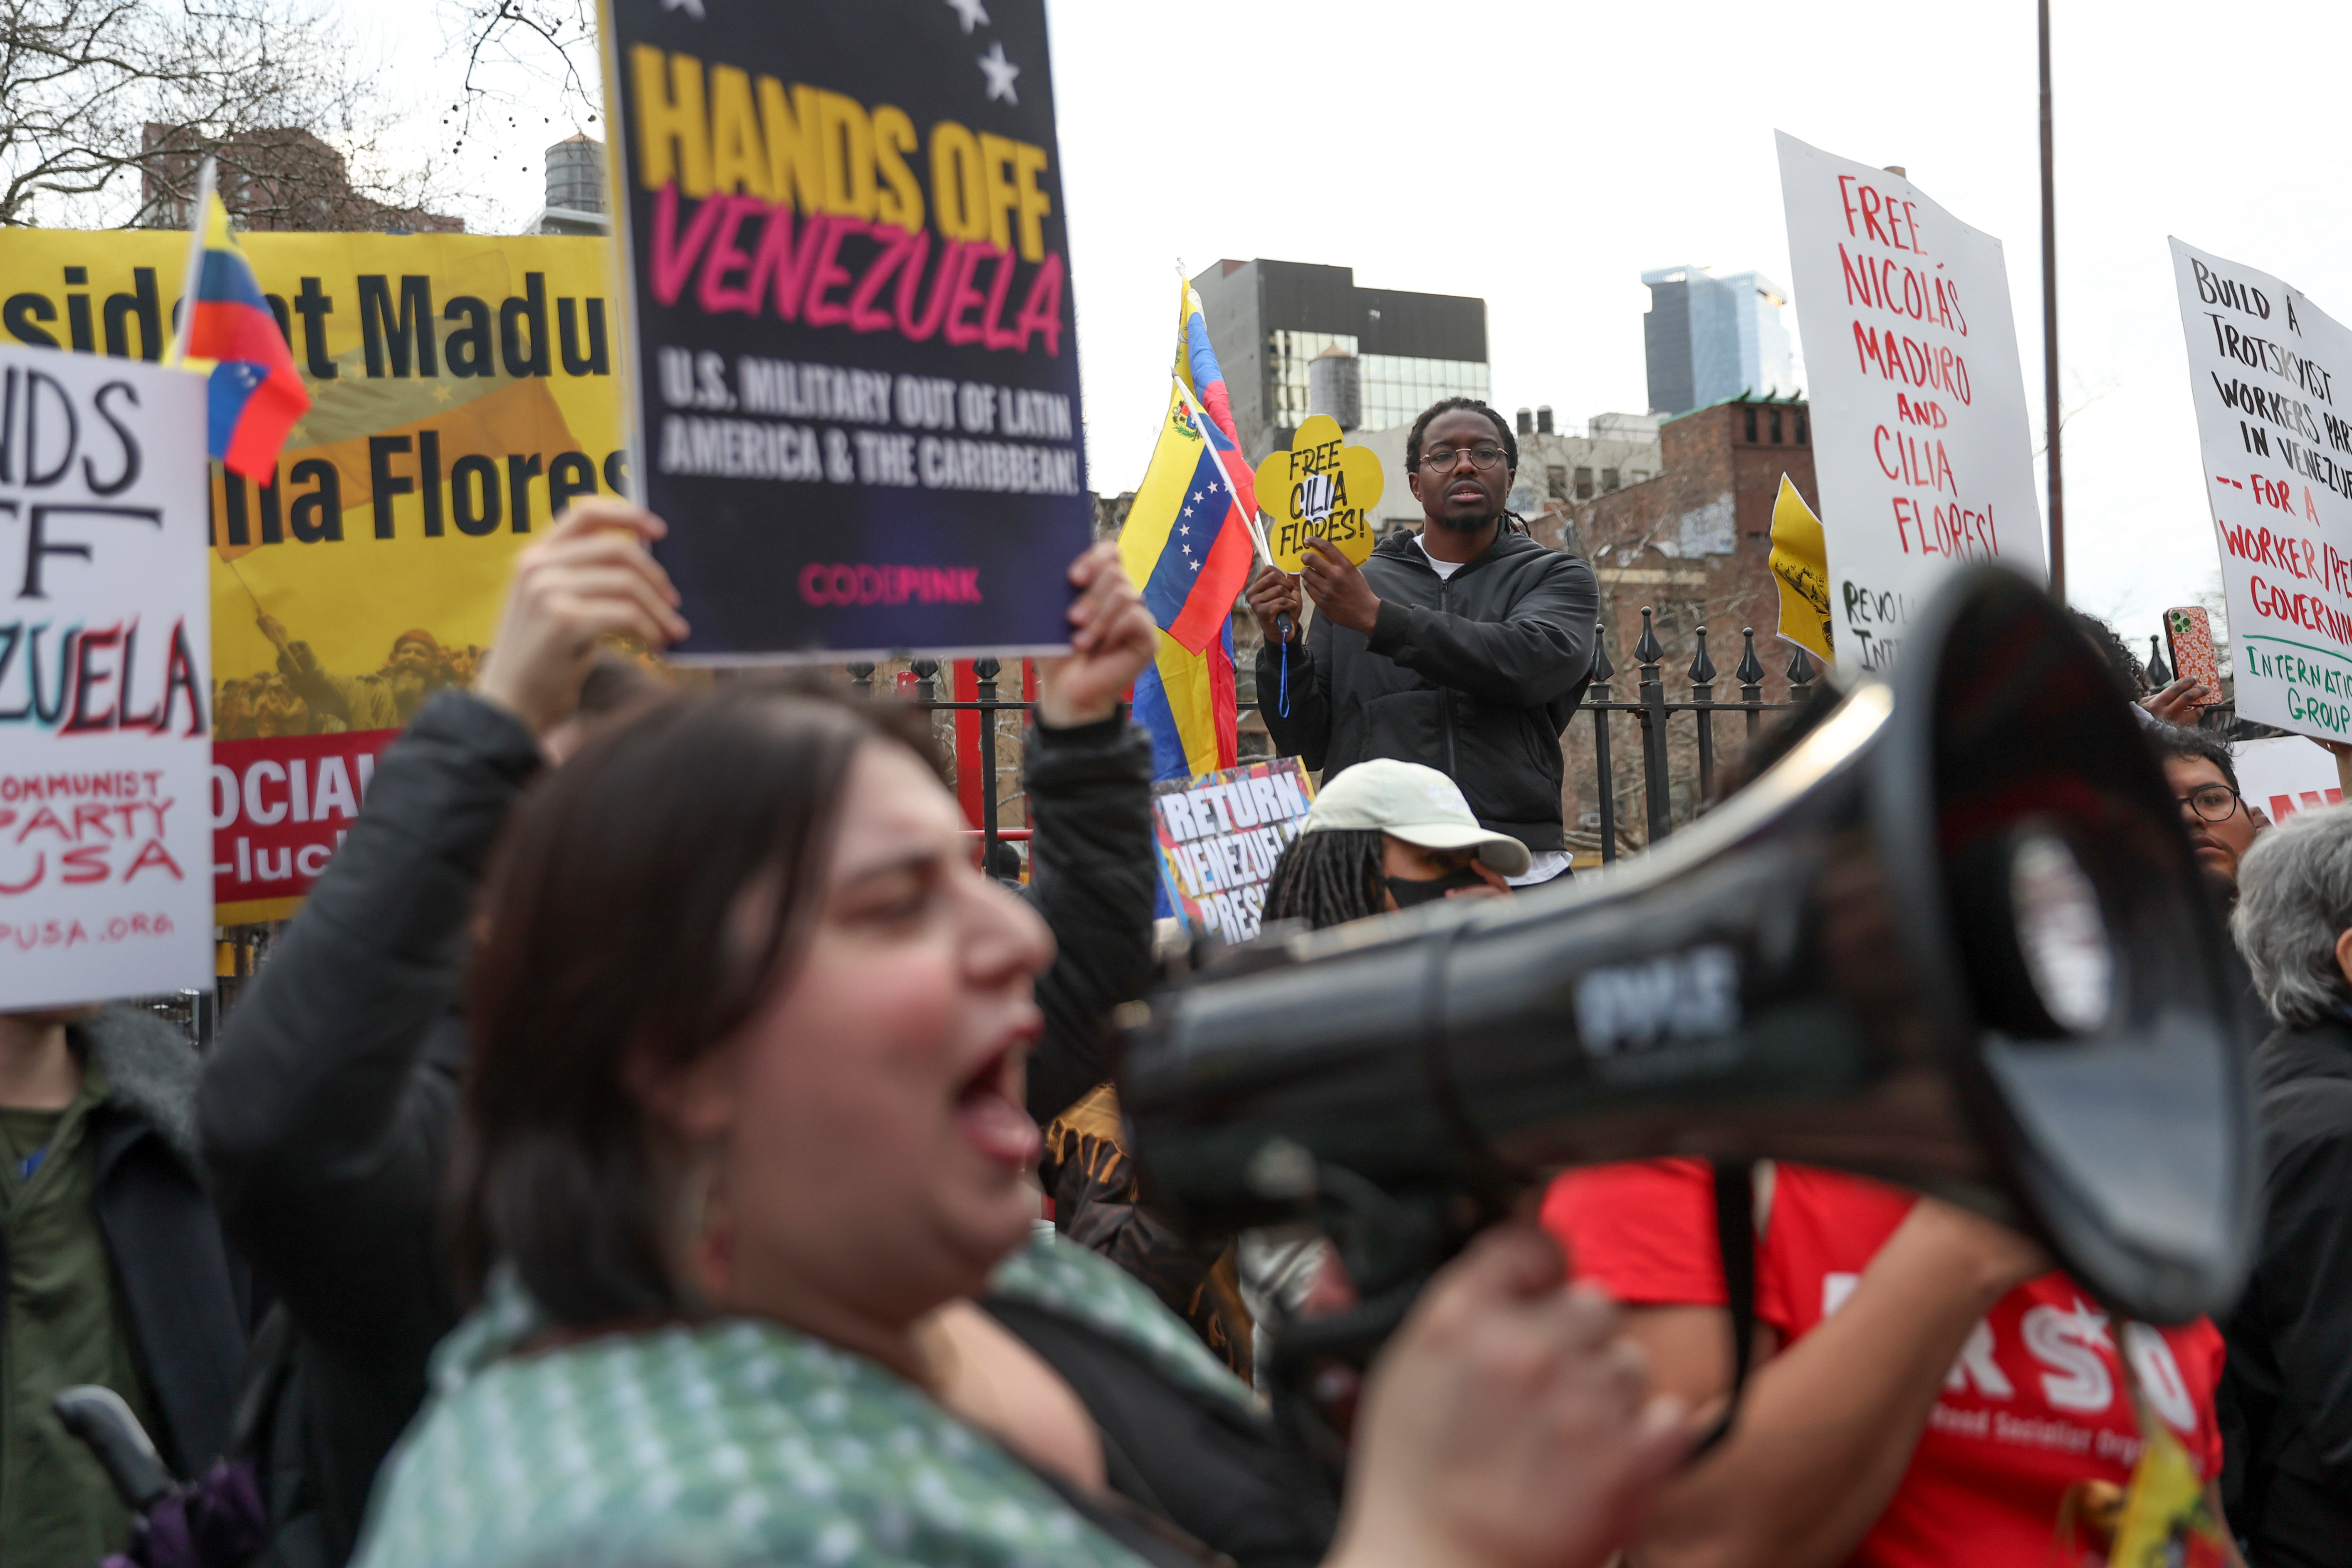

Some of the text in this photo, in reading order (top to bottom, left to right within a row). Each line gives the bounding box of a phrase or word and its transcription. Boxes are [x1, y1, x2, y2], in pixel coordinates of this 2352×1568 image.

[631, 42, 1051, 263] HANDS OFF
[1838, 175, 1927, 256] FREE
[649, 180, 1063, 357] VENEZUELA
[1838, 242, 1967, 337] NICOLÁS
[2191, 257, 2302, 339] BUILD A
[3, 266, 624, 379] sidt Madu
[2204, 311, 2332, 407] TROTSKYIST
[658, 345, 1073, 442] U.S. MILITARY OUT OF LATIN
[1853, 319, 1971, 406] MADURO
[1897, 392, 1947, 429] AND
[2211, 371, 2320, 445] WORKERS
[2240, 420, 2270, 458] IN
[657, 413, 1080, 496] AMERICA & THE CARIBBEAN!
[1290, 439, 1342, 480] FREE
[1874, 424, 1957, 498] CILIA
[1290, 470, 1348, 519] CILIA
[1892, 497, 1998, 565] FLORES!
[2251, 474, 2296, 516] FOR
[2305, 485, 2320, 528] A
[0, 500, 163, 602] F
[1280, 509, 1365, 556] FLORES!
[2219, 520, 2352, 599] WORKER/PE
[799, 561, 983, 607] CODEPINK
[1843, 581, 1915, 625] REVOL
[2288, 687, 2350, 734] GROUP
[1162, 771, 1306, 843] RETURN
[214, 829, 347, 884] -luc
[1198, 883, 1270, 946] PRES
